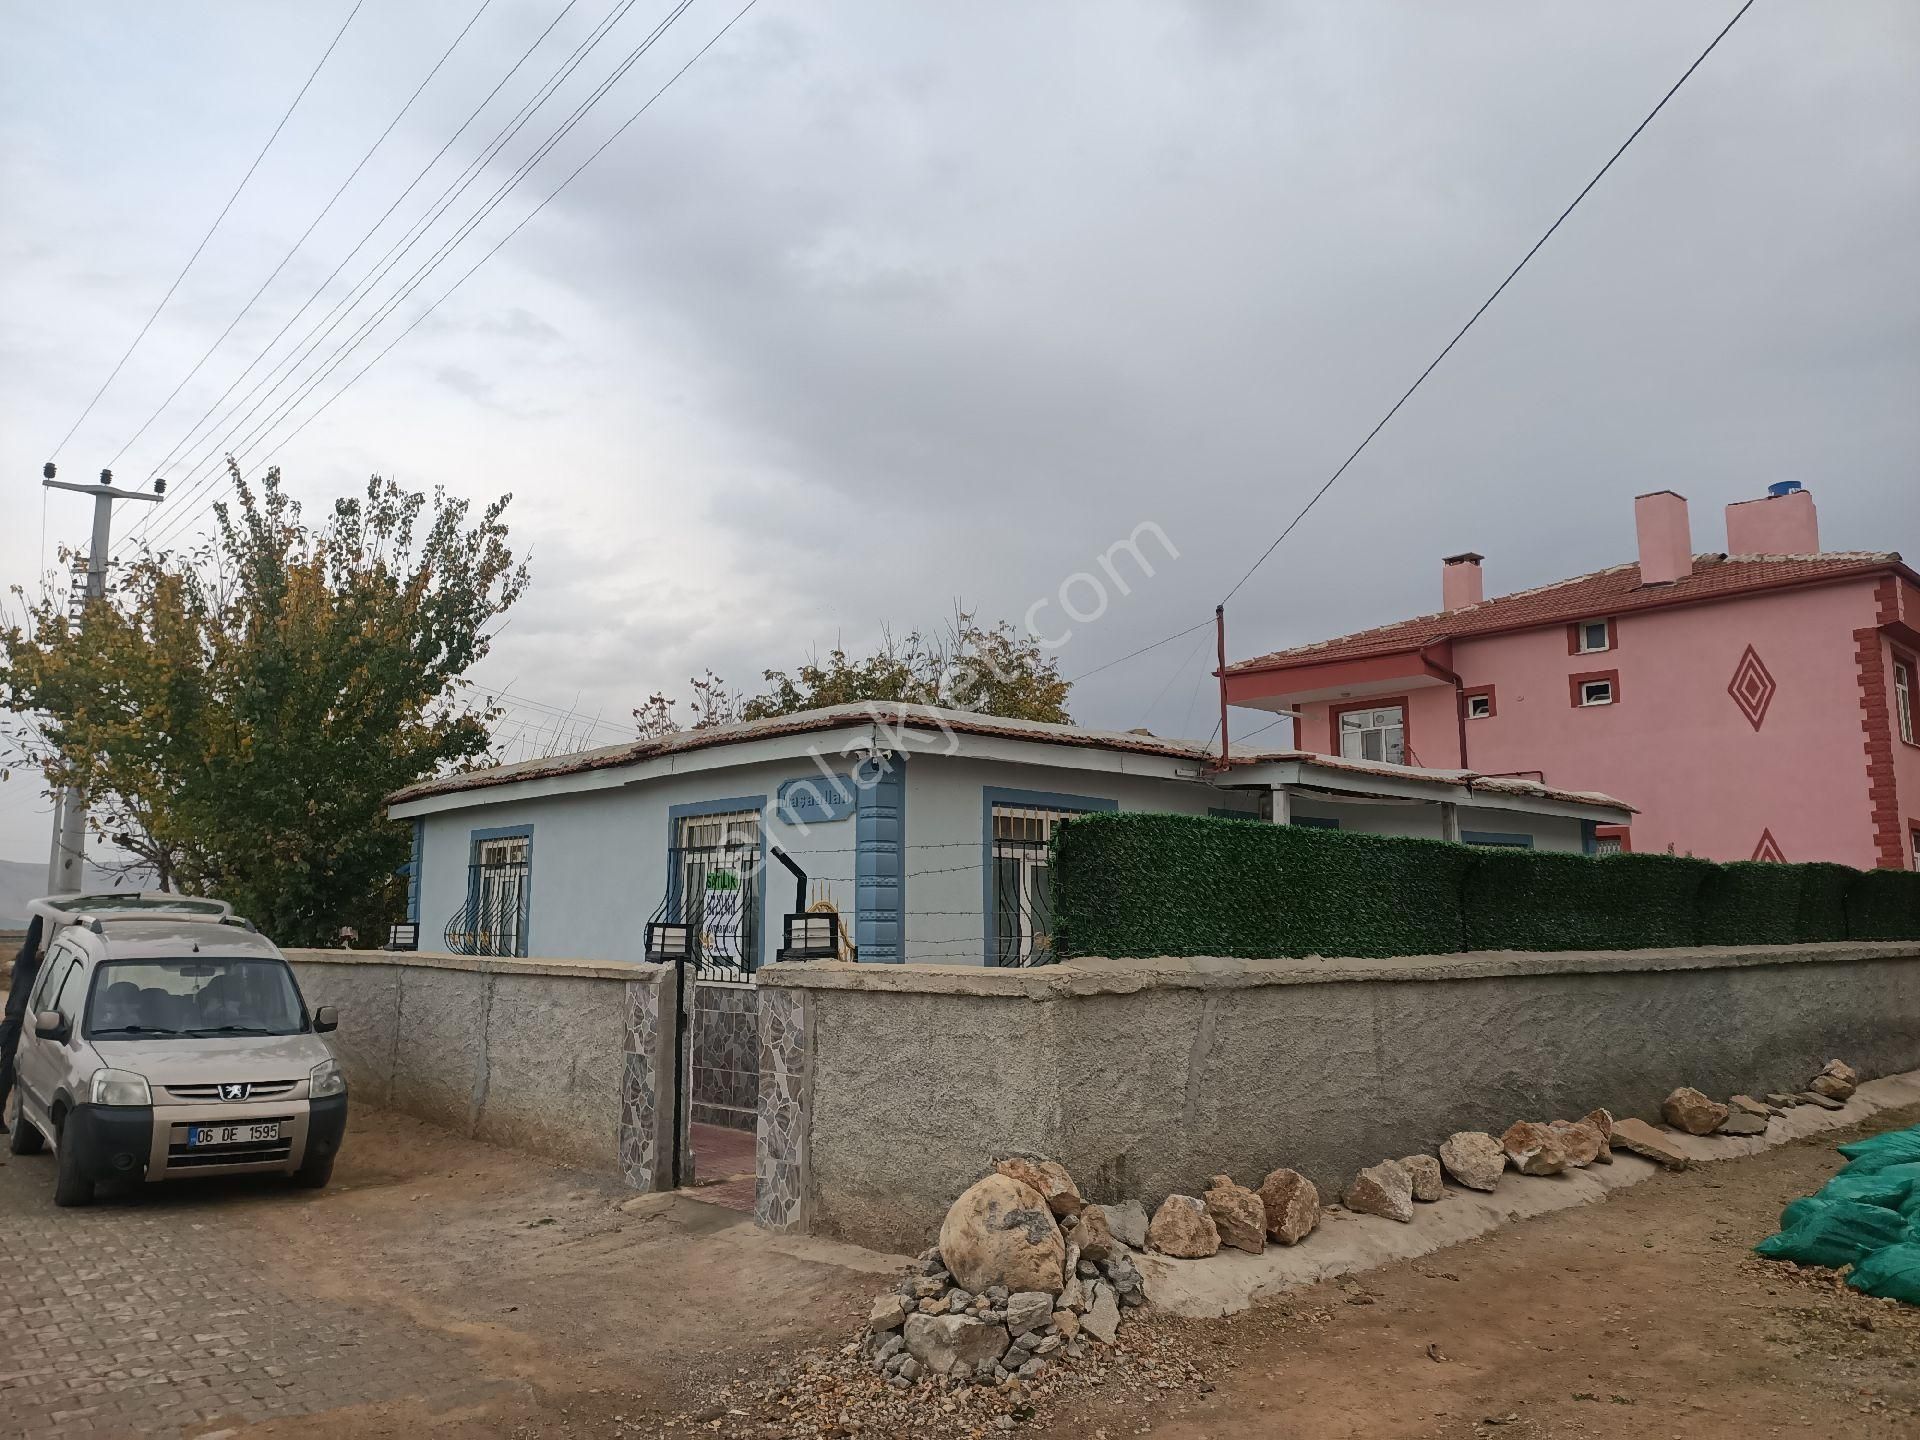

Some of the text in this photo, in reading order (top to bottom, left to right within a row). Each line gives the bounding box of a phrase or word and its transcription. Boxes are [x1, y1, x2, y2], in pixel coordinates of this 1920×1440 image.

[706, 874, 738, 889] SATILIK
[197, 1129, 213, 1143] 06
[221, 1127, 238, 1141] DE
[249, 1125, 277, 1140] 1595
